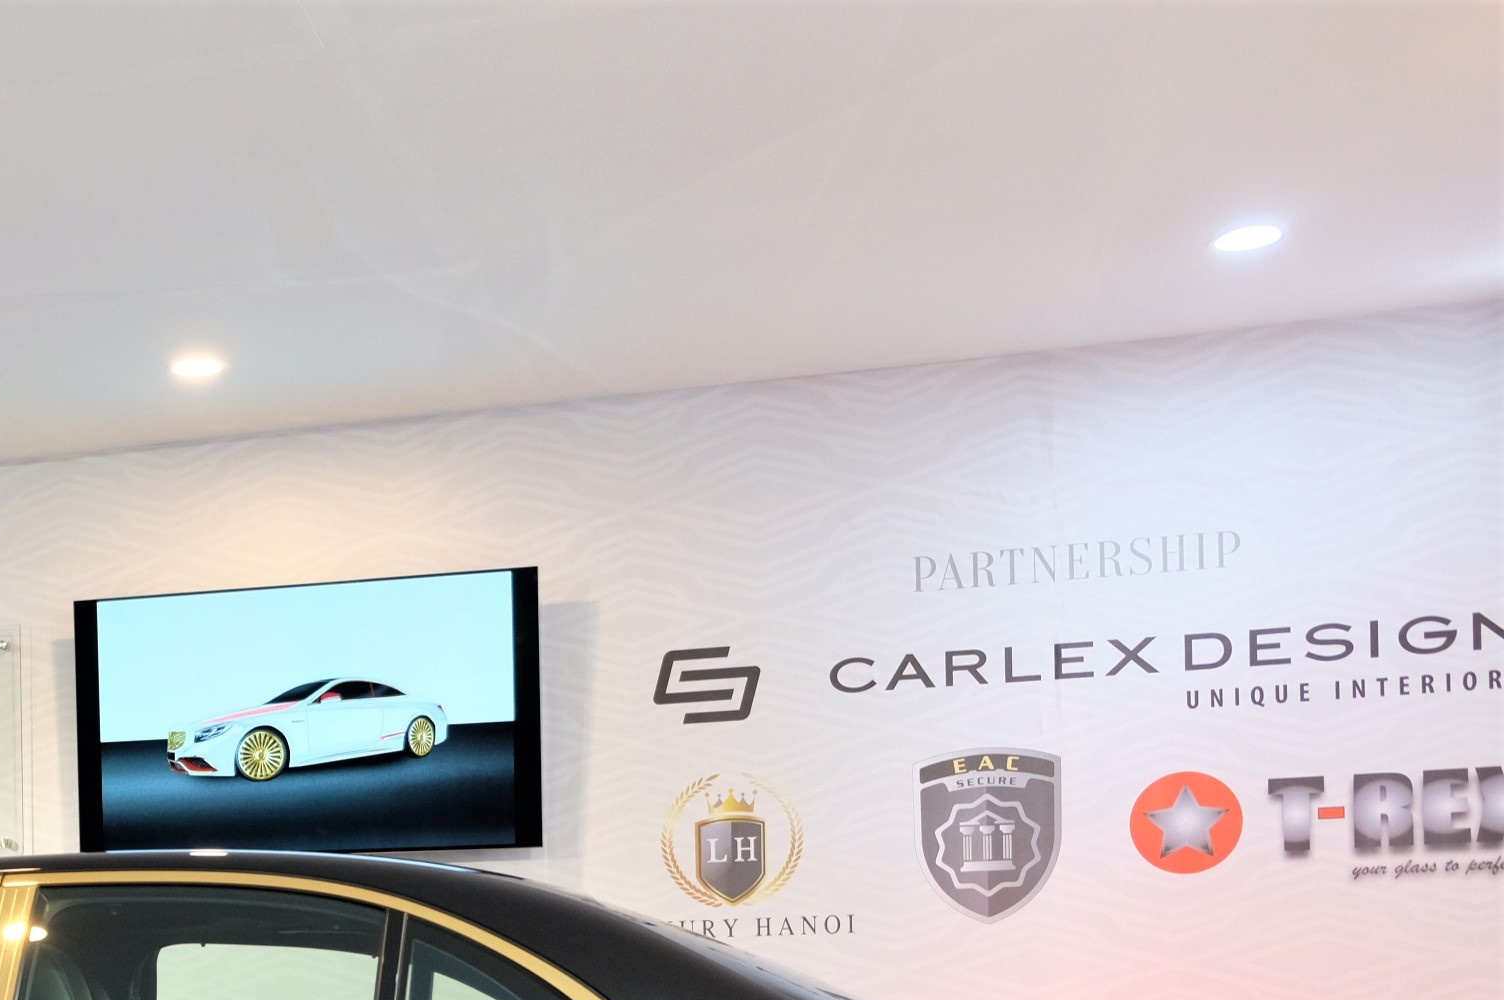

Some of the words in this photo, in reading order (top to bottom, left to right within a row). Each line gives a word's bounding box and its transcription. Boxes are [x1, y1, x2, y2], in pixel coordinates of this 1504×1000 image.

[913, 530, 1241, 592] PARTNERSHIP
[829, 636, 1160, 693] CARLEX
[1186, 683, 1311, 710] UNIQUE
[1335, 670, 1503, 701] INTERIOR
[953, 755, 1020, 774] EAC
[956, 776, 1018, 789] SECURE
[1351, 864, 1388, 881] your
[1394, 859, 1438, 880] glass
[1445, 859, 1460, 872] to
[756, 913, 856, 937] HANOI
